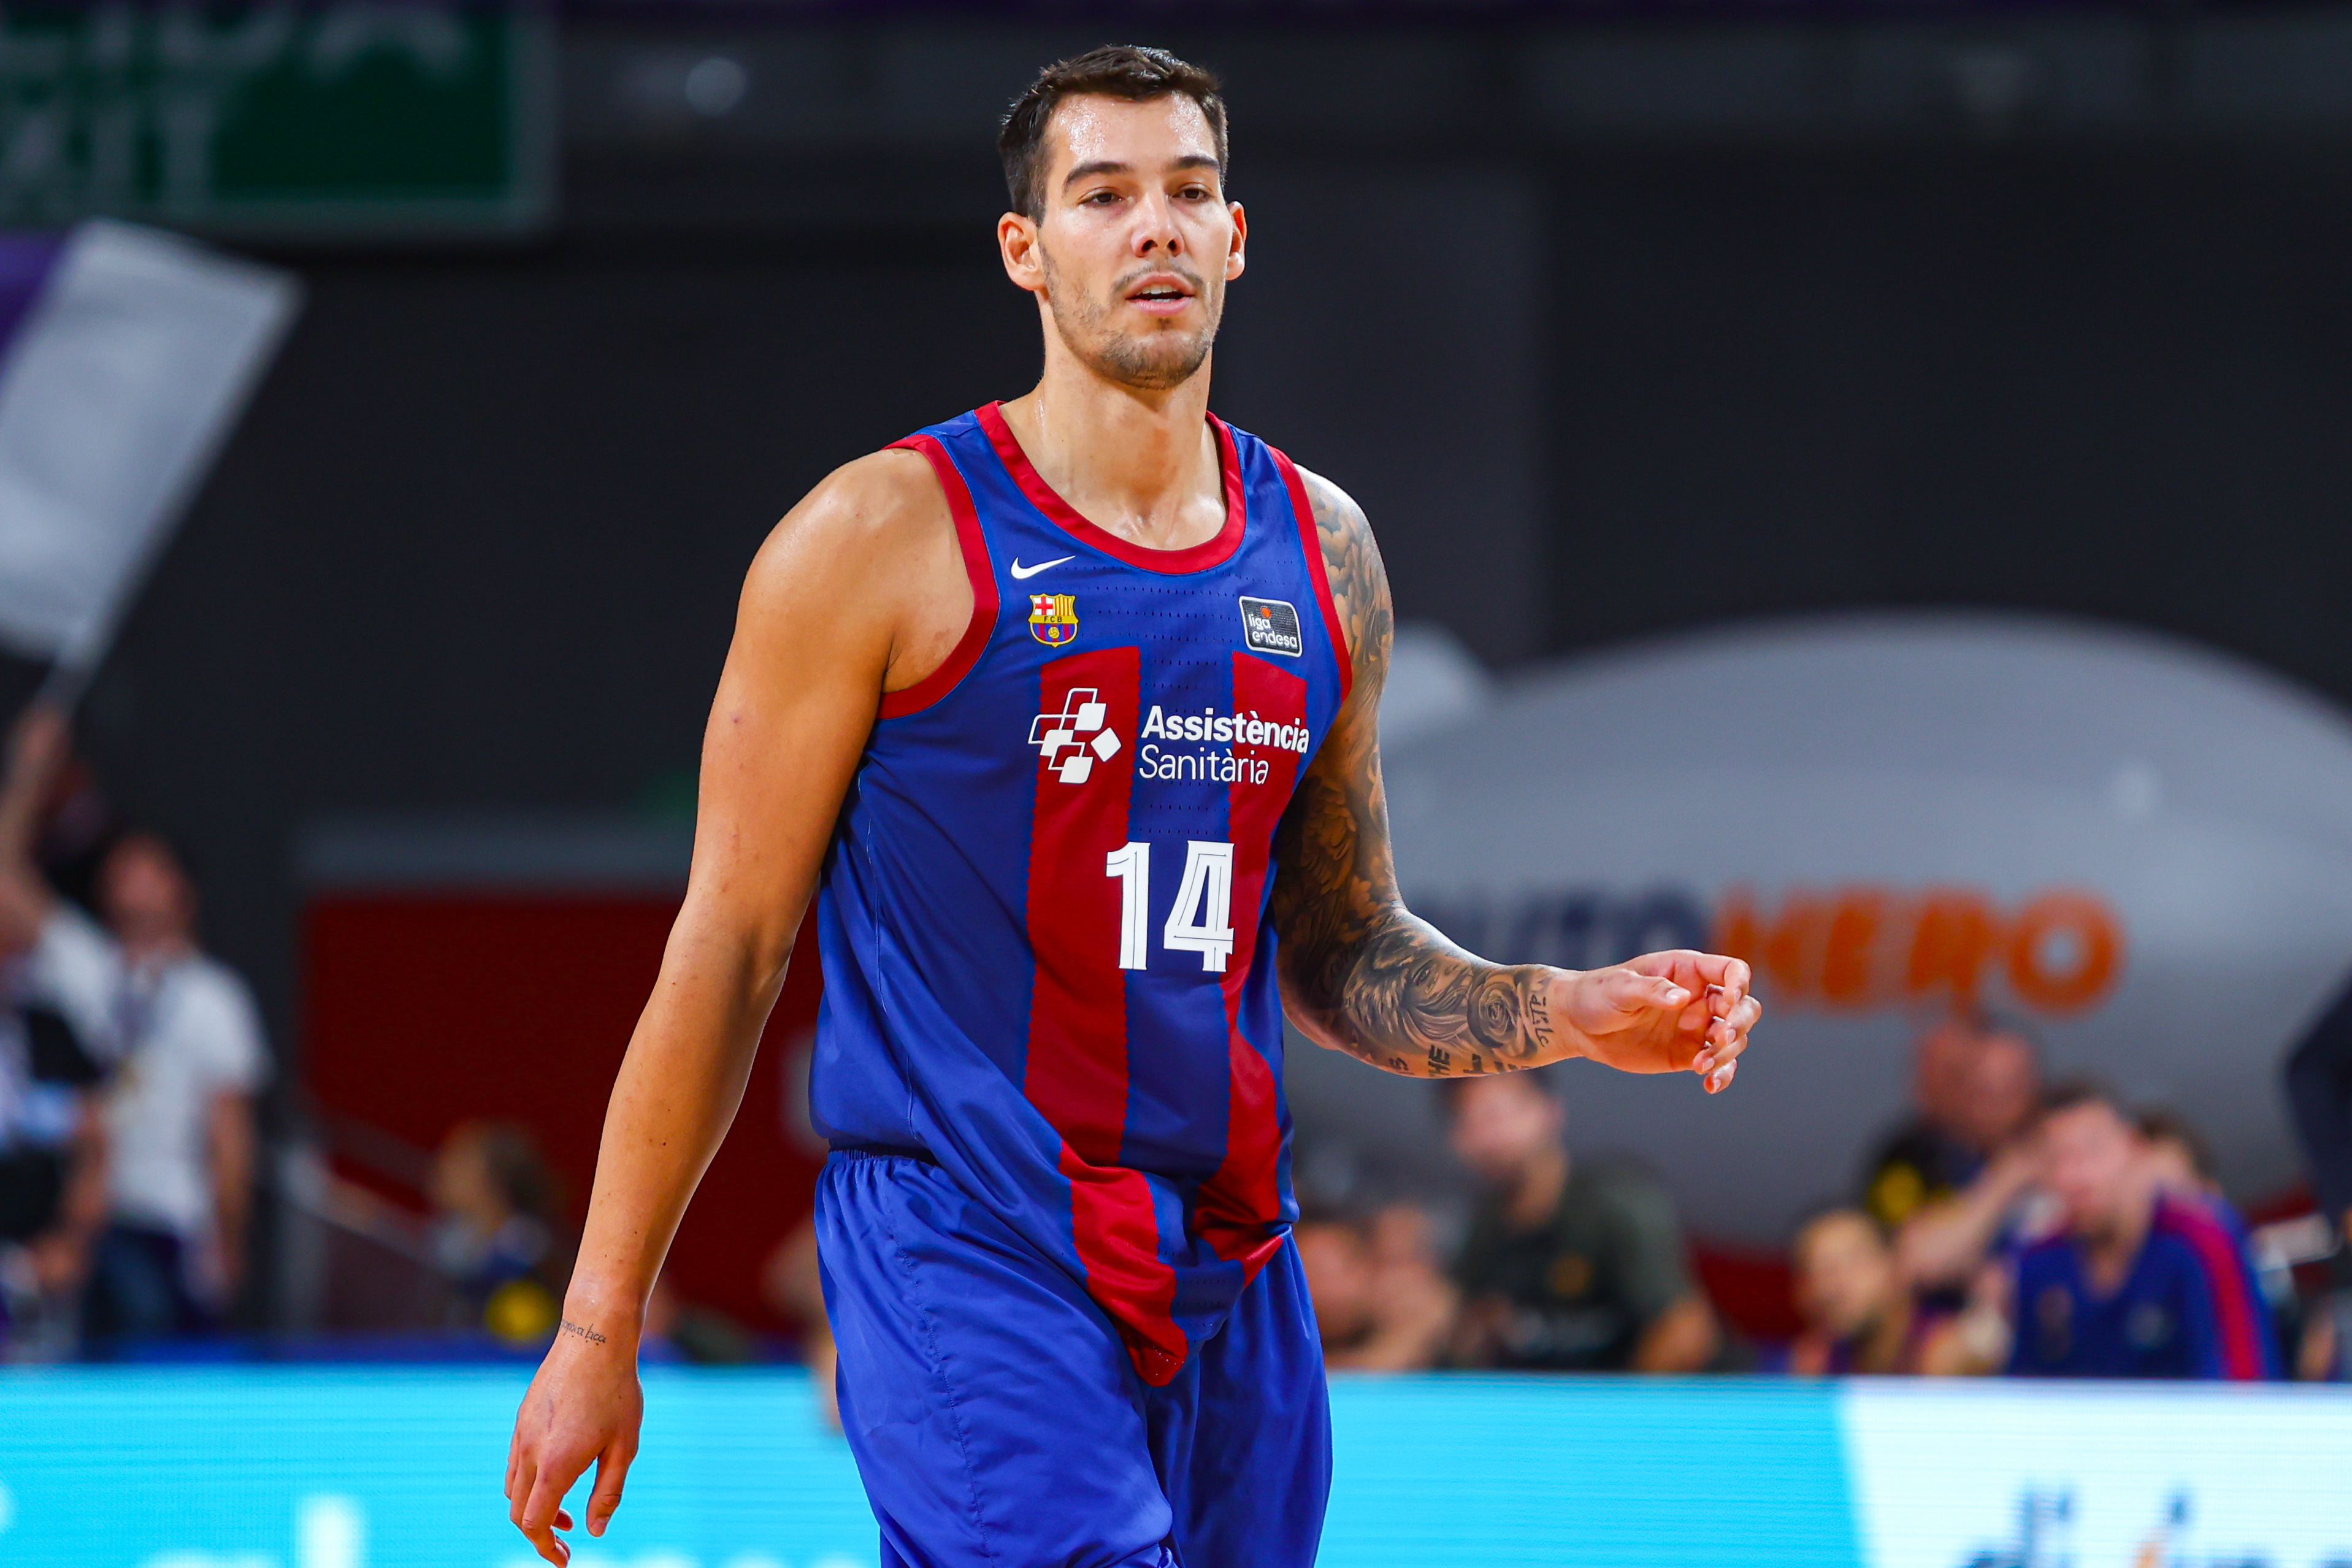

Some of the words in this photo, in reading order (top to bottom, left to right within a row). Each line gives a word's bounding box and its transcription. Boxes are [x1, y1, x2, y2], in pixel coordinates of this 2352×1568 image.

[1248, 613, 1271, 630] liga
[1252, 630, 1298, 648] endesa
[1141, 705, 1309, 753] Assistència
[1139, 744, 1269, 784] Sanitària
[1106, 840, 1235, 973] 14
